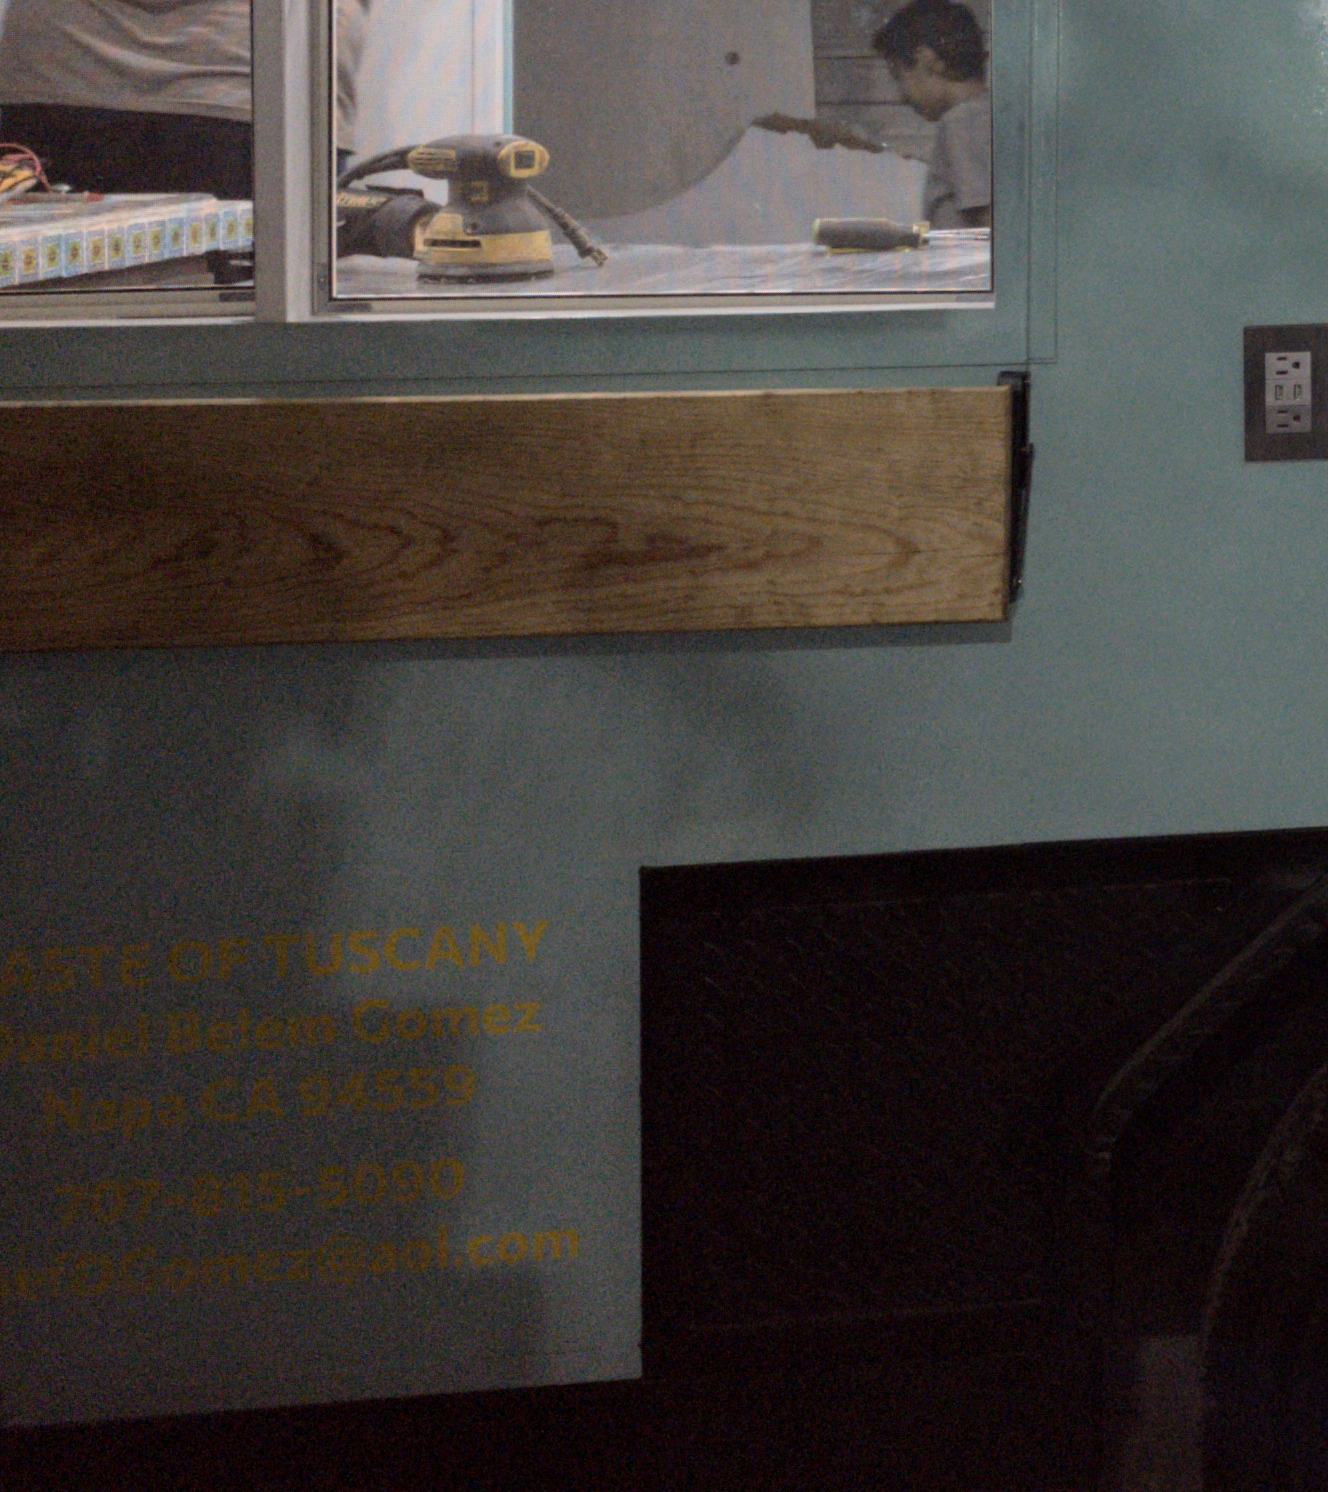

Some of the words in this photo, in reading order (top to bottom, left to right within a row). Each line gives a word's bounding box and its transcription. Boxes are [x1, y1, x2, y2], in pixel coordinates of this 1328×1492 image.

[165, 935, 252, 984] OF
[263, 918, 550, 978] TUSCANY
[350, 996, 544, 1045] Gomez
[40, 1086, 188, 1139] Napa
[200, 1076, 287, 1123] CA
[297, 1062, 479, 1117] 94559
[55, 1155, 467, 1229] 707-815-5090
